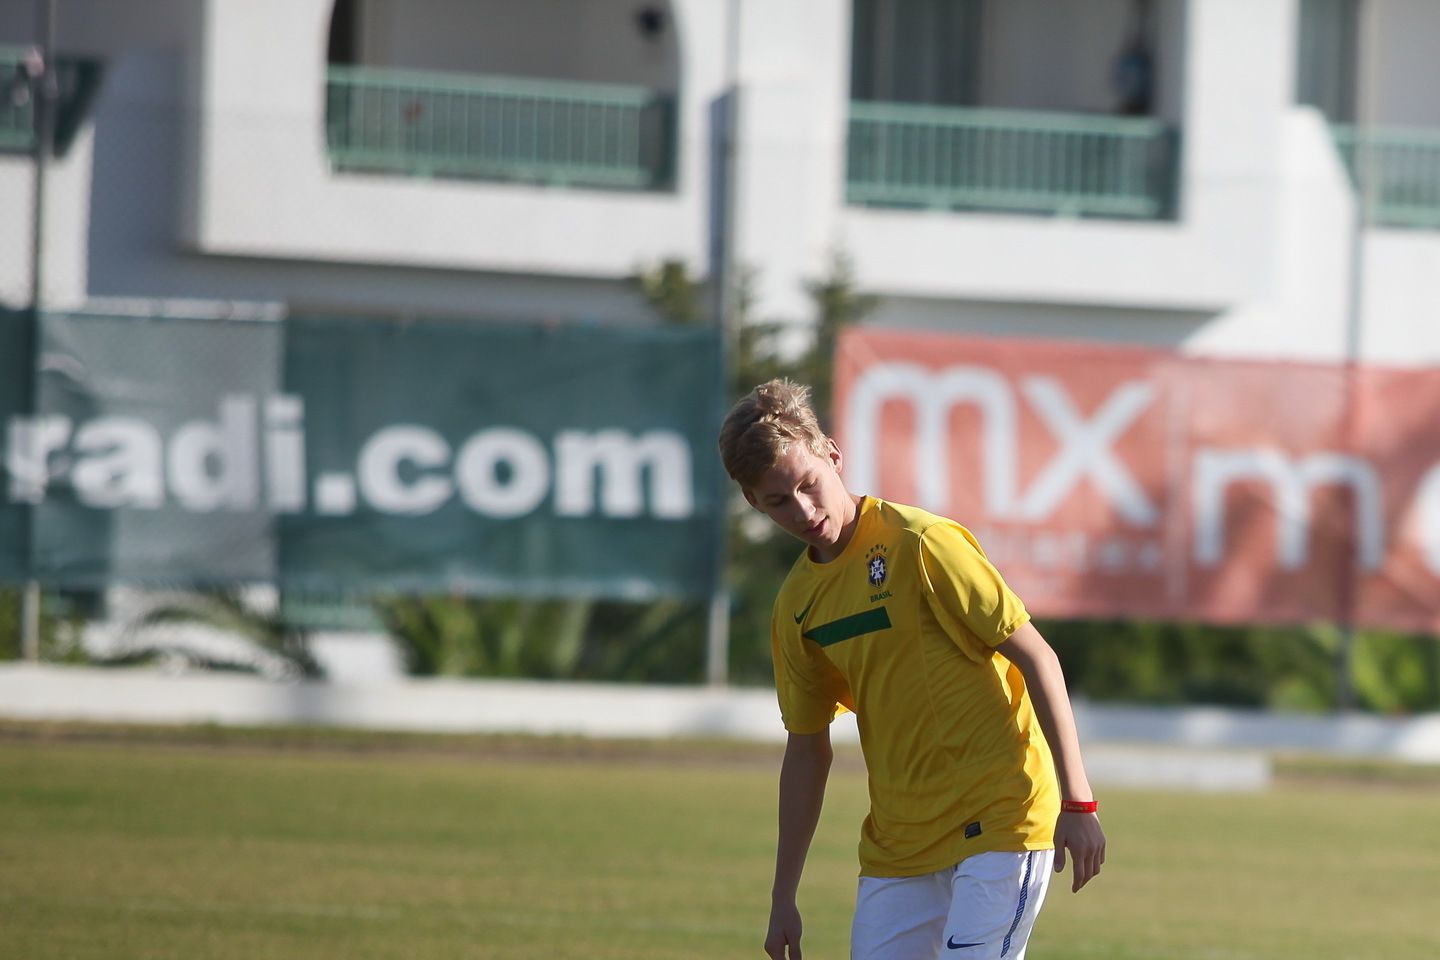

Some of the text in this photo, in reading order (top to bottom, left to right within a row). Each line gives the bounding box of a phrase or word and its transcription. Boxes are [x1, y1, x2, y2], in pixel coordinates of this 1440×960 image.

[7, 393, 696, 519] radi.com
[842, 362, 1161, 525] mx
[870, 590, 892, 602] BRASIL
